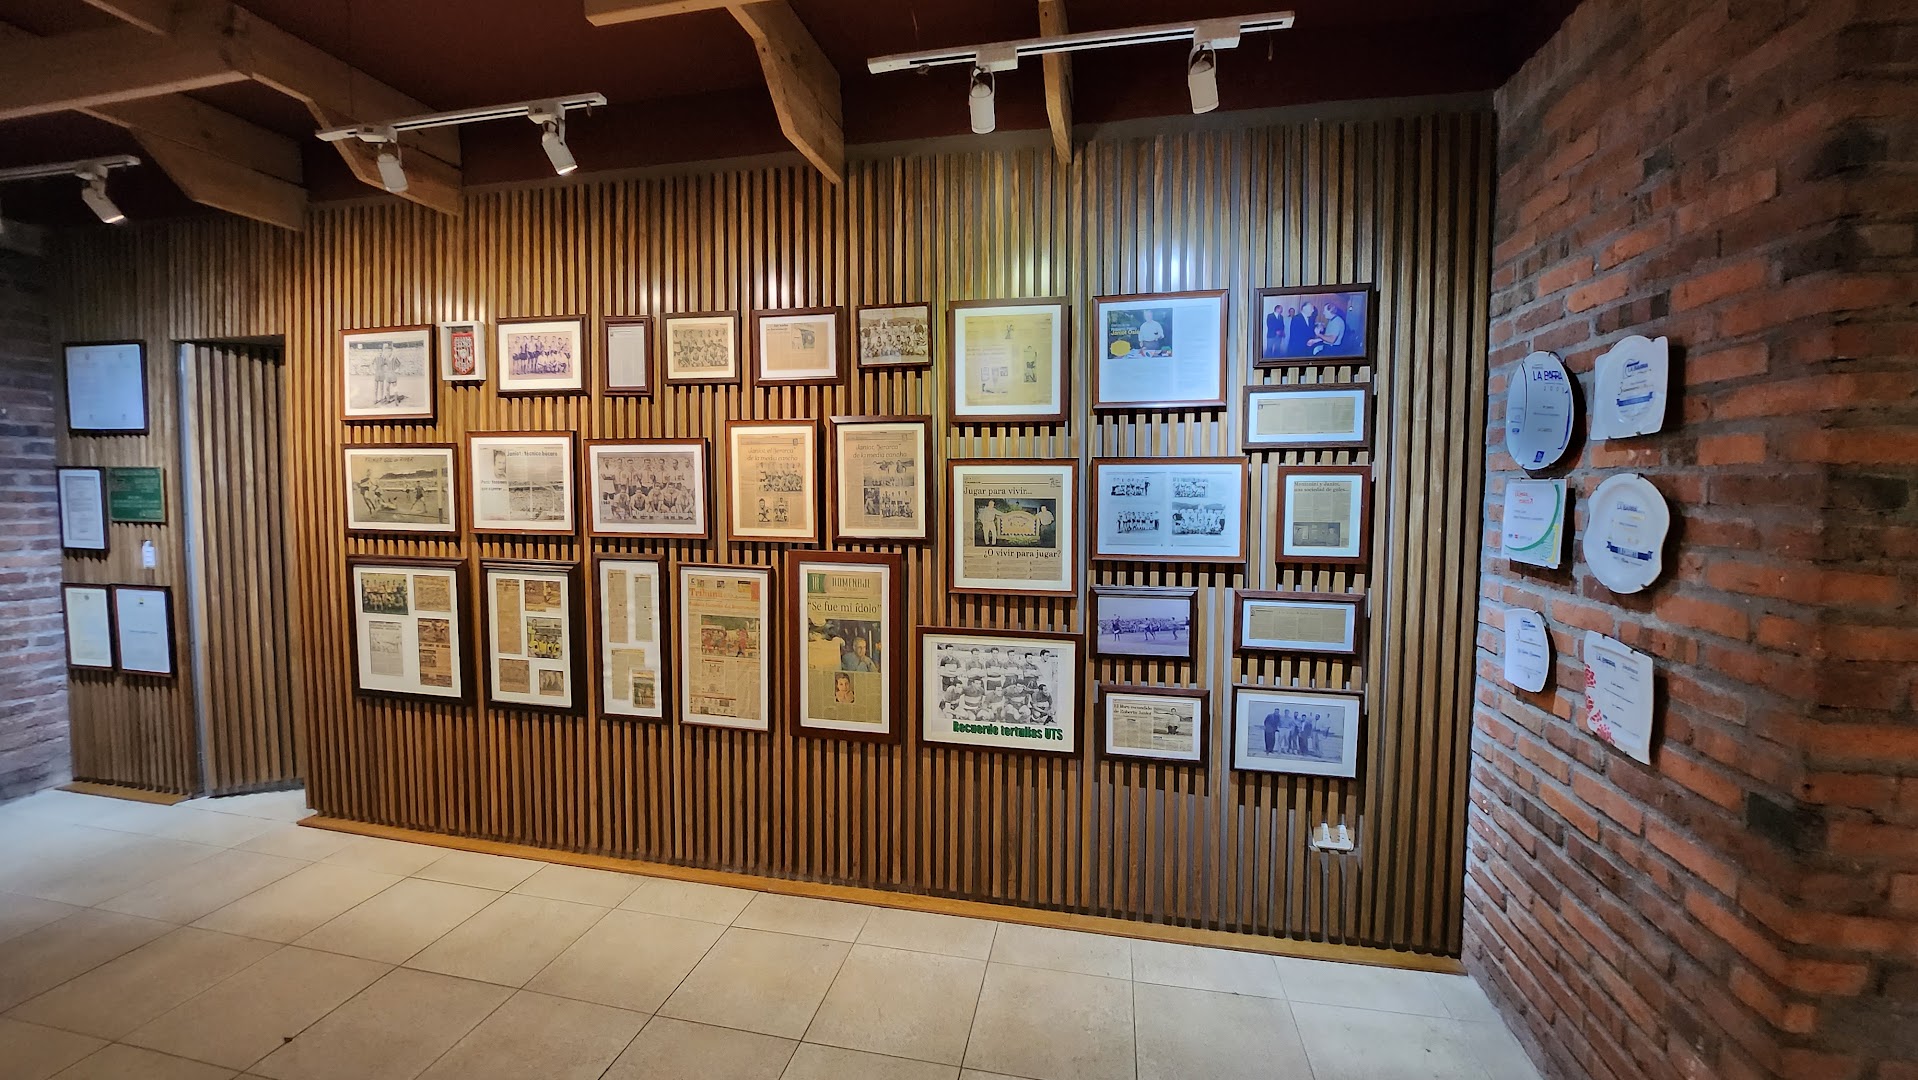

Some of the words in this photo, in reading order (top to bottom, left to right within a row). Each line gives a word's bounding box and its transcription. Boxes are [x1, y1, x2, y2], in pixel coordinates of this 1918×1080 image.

[1533, 370, 1543, 381] LA
[963, 487, 986, 496] Jugar
[988, 488, 1006, 496] para
[983, 548, 994, 559] ¿O
[996, 549, 1014, 557] vivir
[1016, 550, 1034, 559] para
[1035, 549, 1062, 560] jugar?
[823, 602, 838, 612] fue
[840, 603, 853, 613] mi
[953, 720, 999, 736] Recuerdo
[1000, 725, 1043, 739] tertulias
[1044, 728, 1064, 741] UTS
